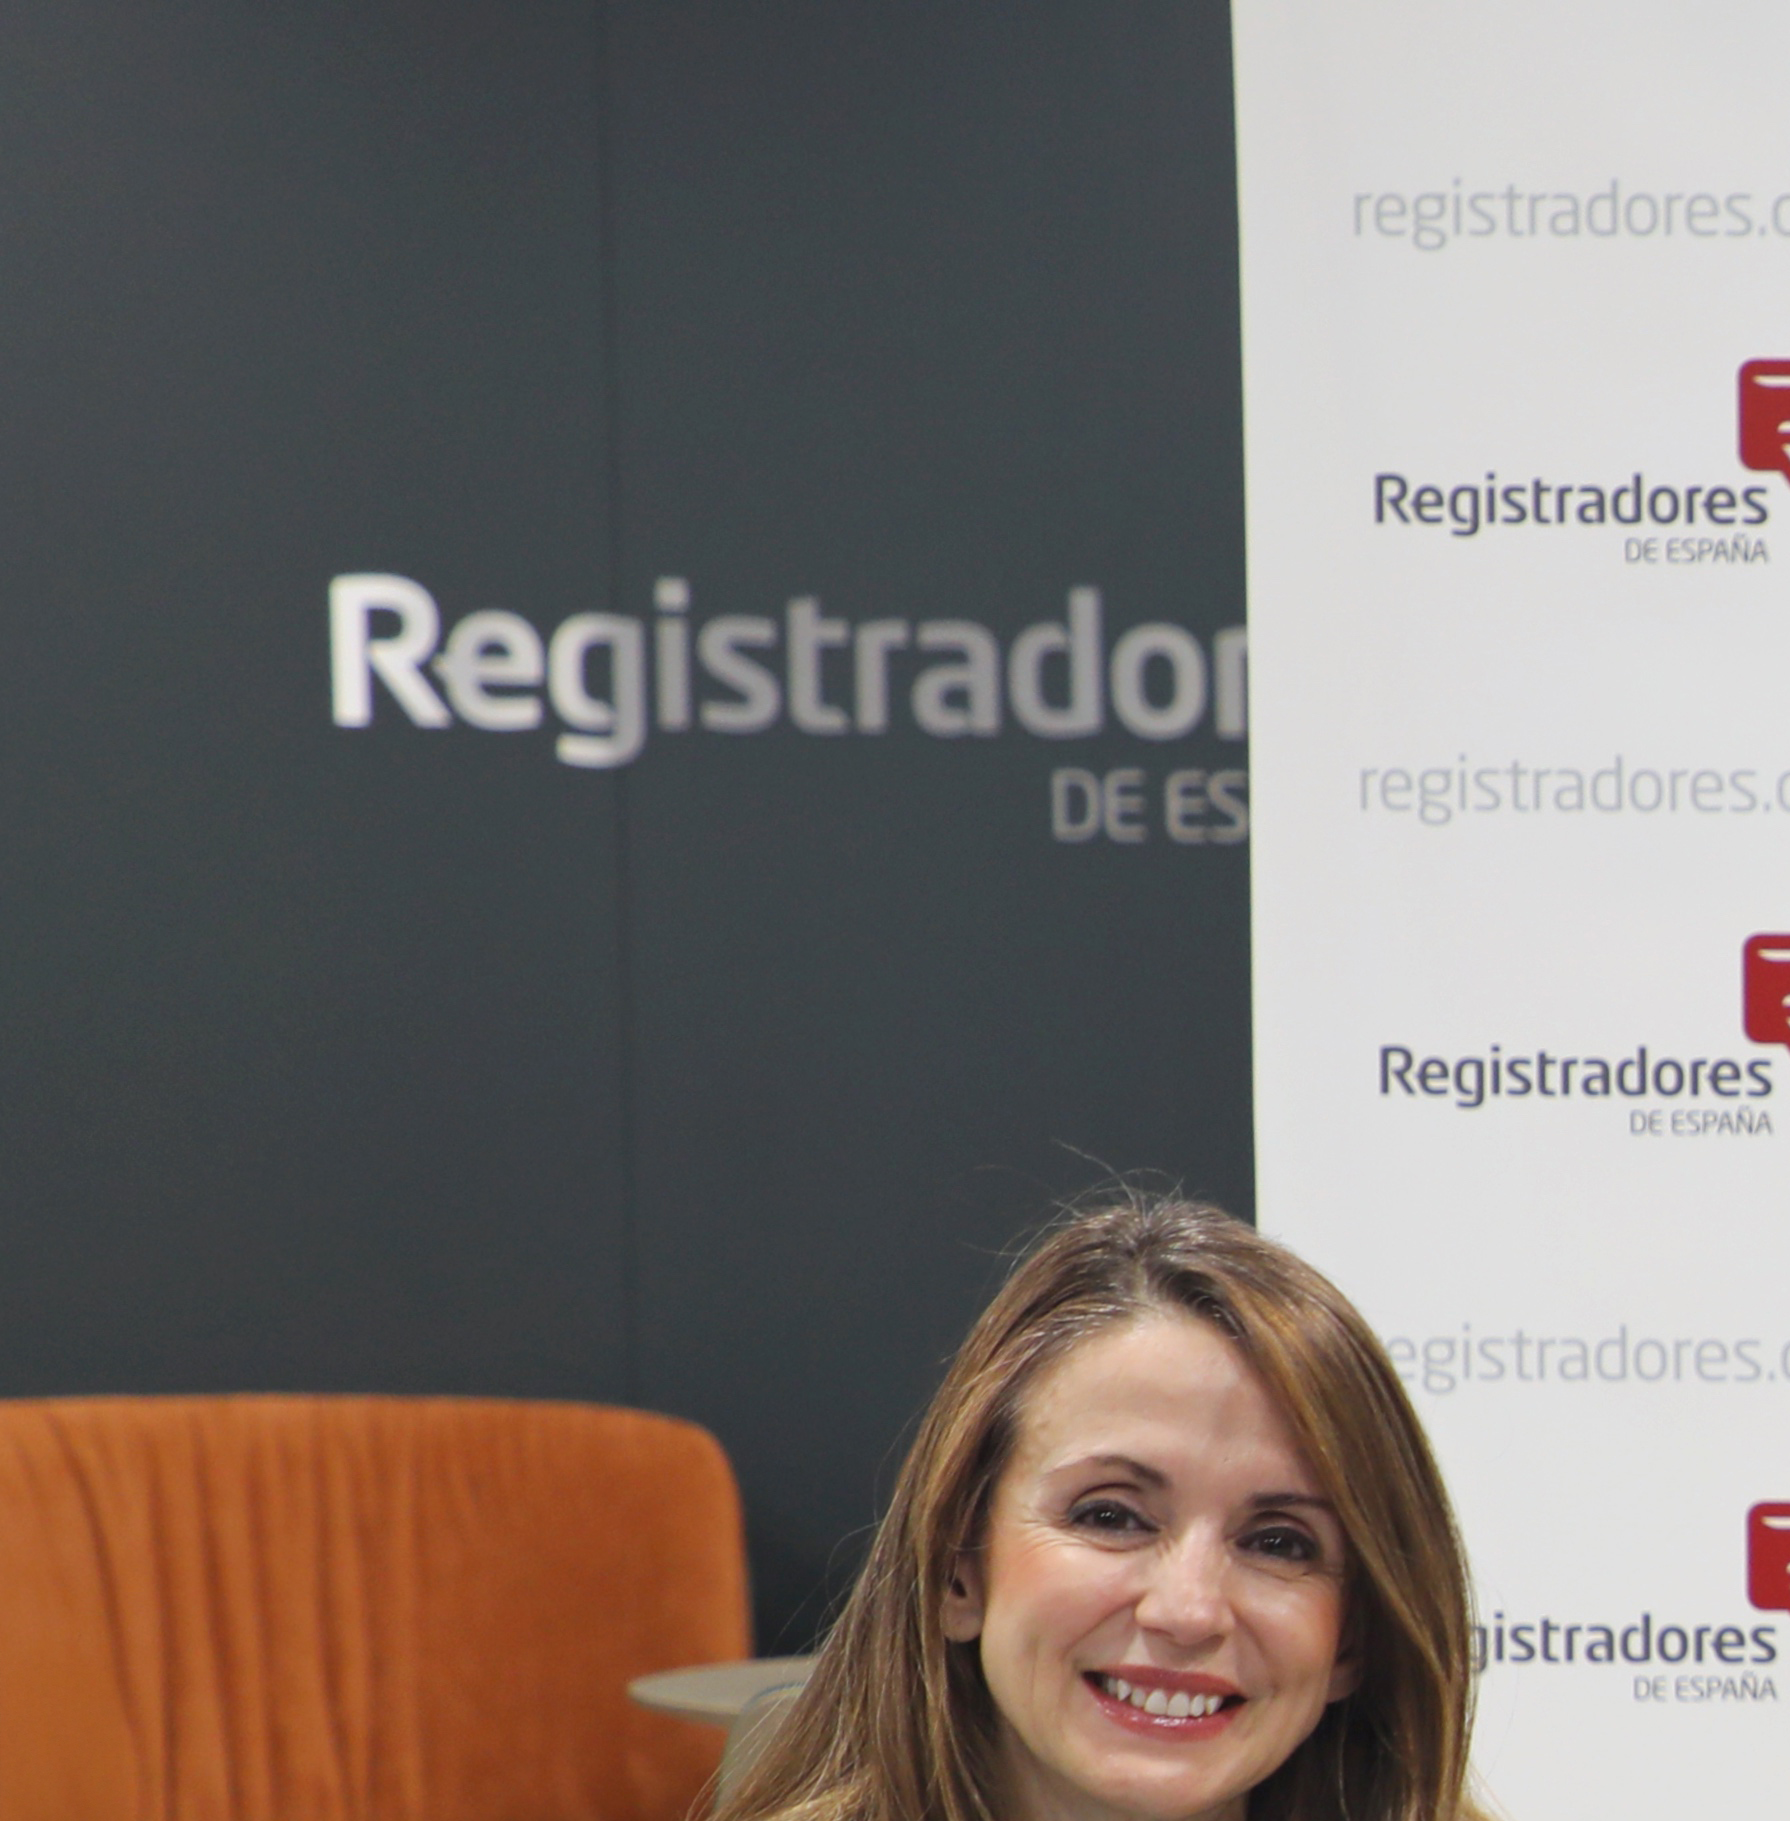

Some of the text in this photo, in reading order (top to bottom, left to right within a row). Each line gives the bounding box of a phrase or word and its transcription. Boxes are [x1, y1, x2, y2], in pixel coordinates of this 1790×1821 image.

[1373, 471, 1770, 538] Registradores
[1625, 533, 1769, 565] DE ESPAÑA
[327, 572, 1247, 769] Registrador
[1050, 767, 1147, 845] DE
[1379, 1042, 1773, 1109] Registradores
[1630, 1105, 1773, 1136] DE ESPAÑA
[1474, 1612, 1778, 1670] gistradores
[1634, 1671, 1778, 1702] DE ESPAÑA
